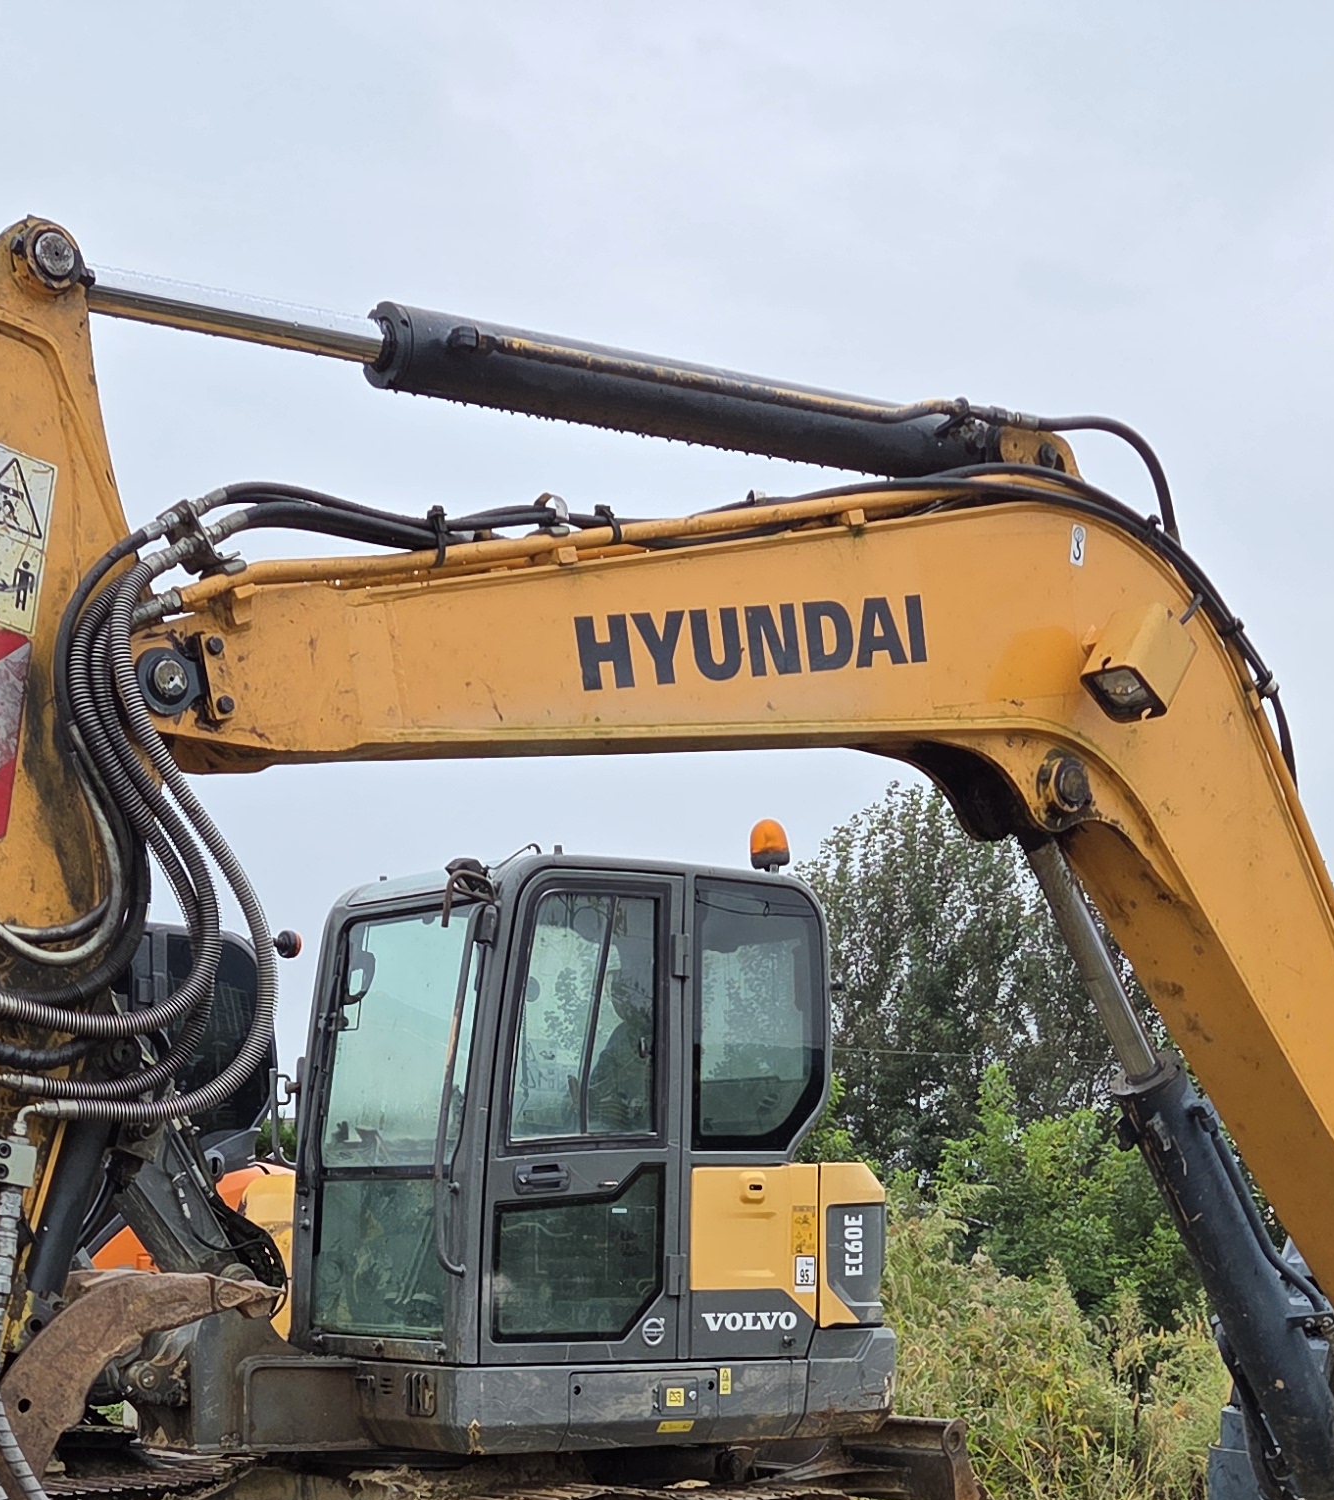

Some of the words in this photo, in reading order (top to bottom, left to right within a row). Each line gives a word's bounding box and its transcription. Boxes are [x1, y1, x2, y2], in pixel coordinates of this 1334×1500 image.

[574, 594, 927, 691] HYUNDAI
[844, 1214, 863, 1276] EC60E
[799, 1268, 810, 1283] 95
[701, 1311, 798, 1332] VOLVO
